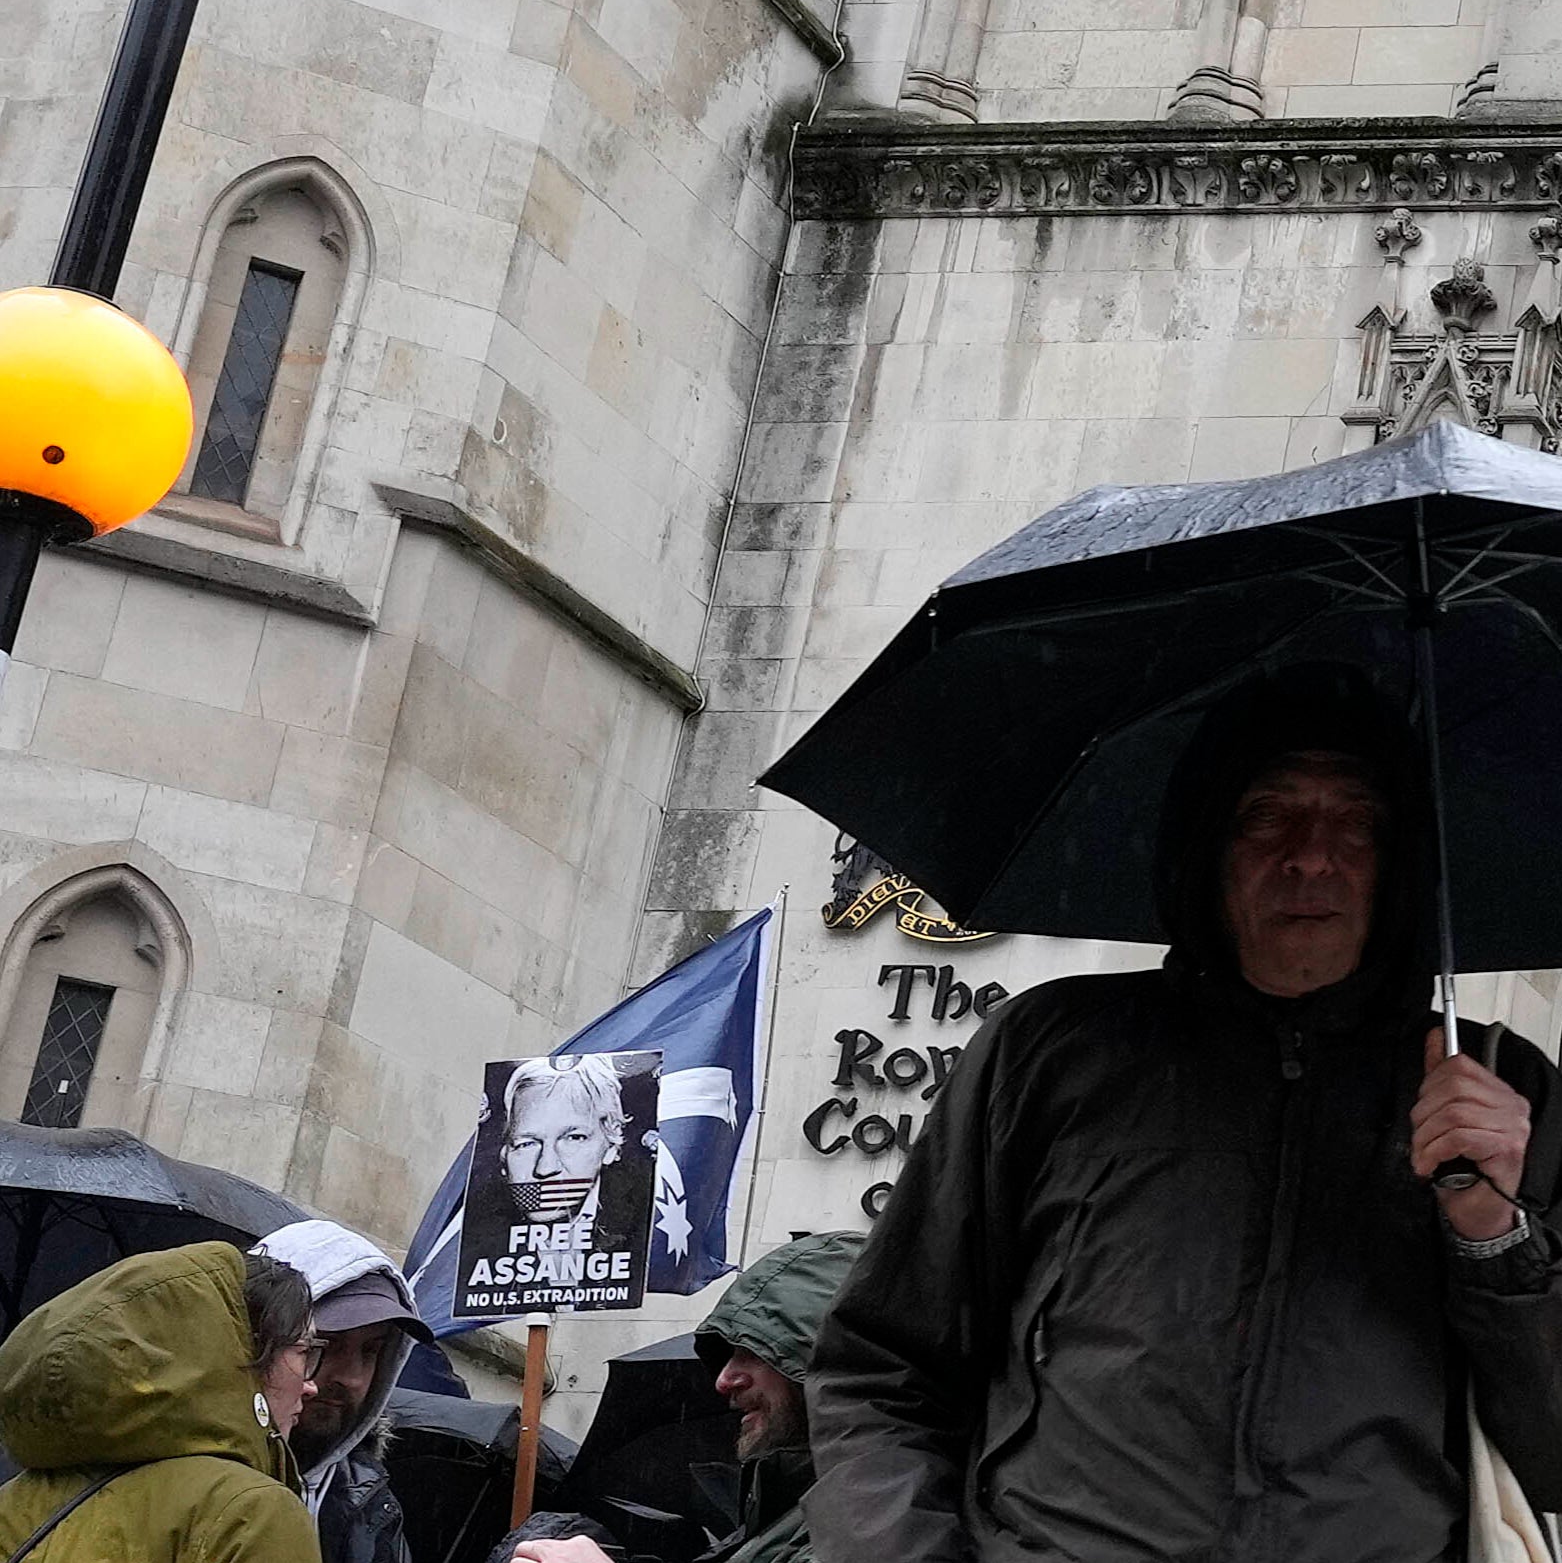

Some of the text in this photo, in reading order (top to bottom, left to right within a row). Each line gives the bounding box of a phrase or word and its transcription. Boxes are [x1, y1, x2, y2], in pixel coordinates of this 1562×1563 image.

[877, 964, 1010, 1021] The
[831, 1029, 967, 1100] Roy
[803, 1097, 930, 1156] Cou
[509, 1223, 592, 1253] FREE
[468, 1252, 631, 1286] ASSANGE
[466, 1287, 628, 1307] NO U.S. EXTRADITION
